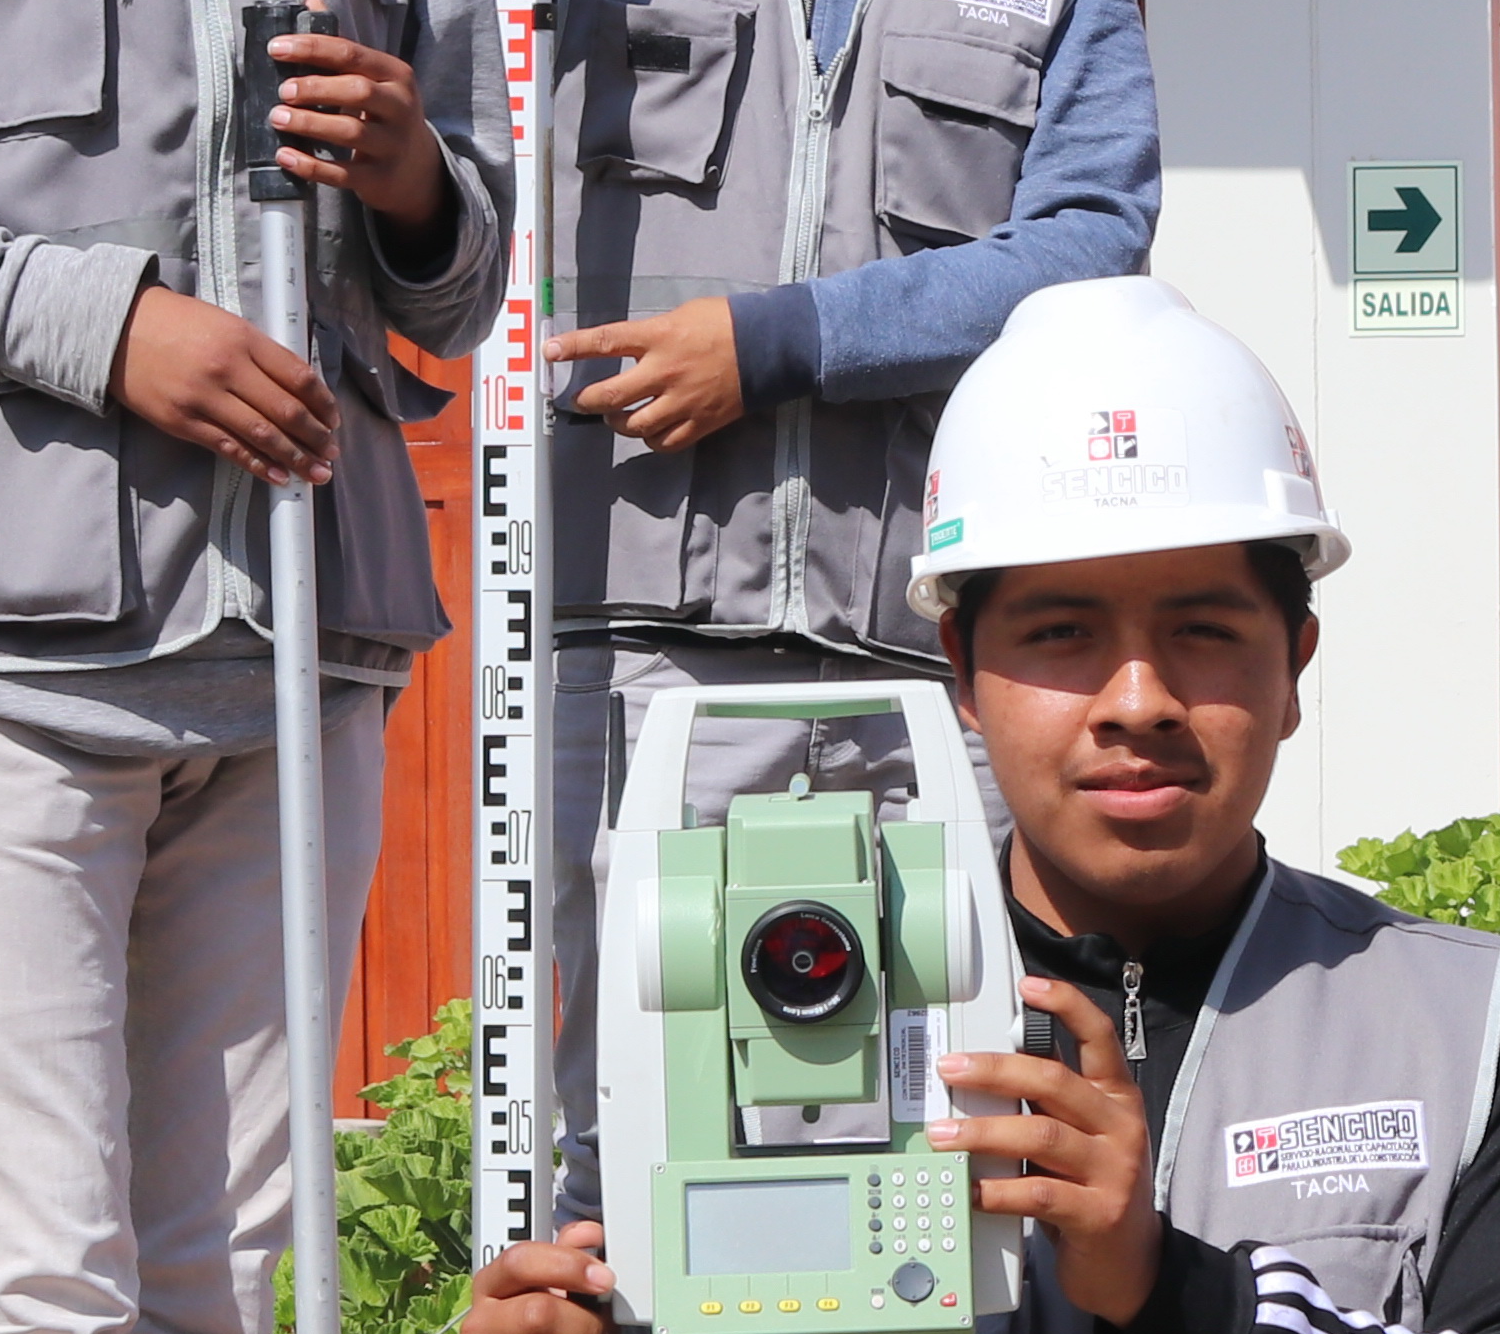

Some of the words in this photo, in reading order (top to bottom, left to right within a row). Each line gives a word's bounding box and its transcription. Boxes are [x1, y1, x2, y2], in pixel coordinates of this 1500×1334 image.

[957, 3, 1010, 27] TACNA
[1362, 291, 1451, 317] SALIDA
[483, 375, 506, 431] 10
[1041, 465, 1188, 503] SENCICO
[1094, 497, 1138, 508] TACNA
[508, 520, 532, 575] 09
[483, 665, 506, 720] 08
[508, 810, 532, 865] 07
[483, 955, 506, 1010] 06
[508, 1100, 532, 1155] 05
[1278, 1109, 1417, 1151] SENCICO
[1280, 1149, 1312, 1162] SERVICIO
[1291, 1174, 1370, 1200] TACNA
